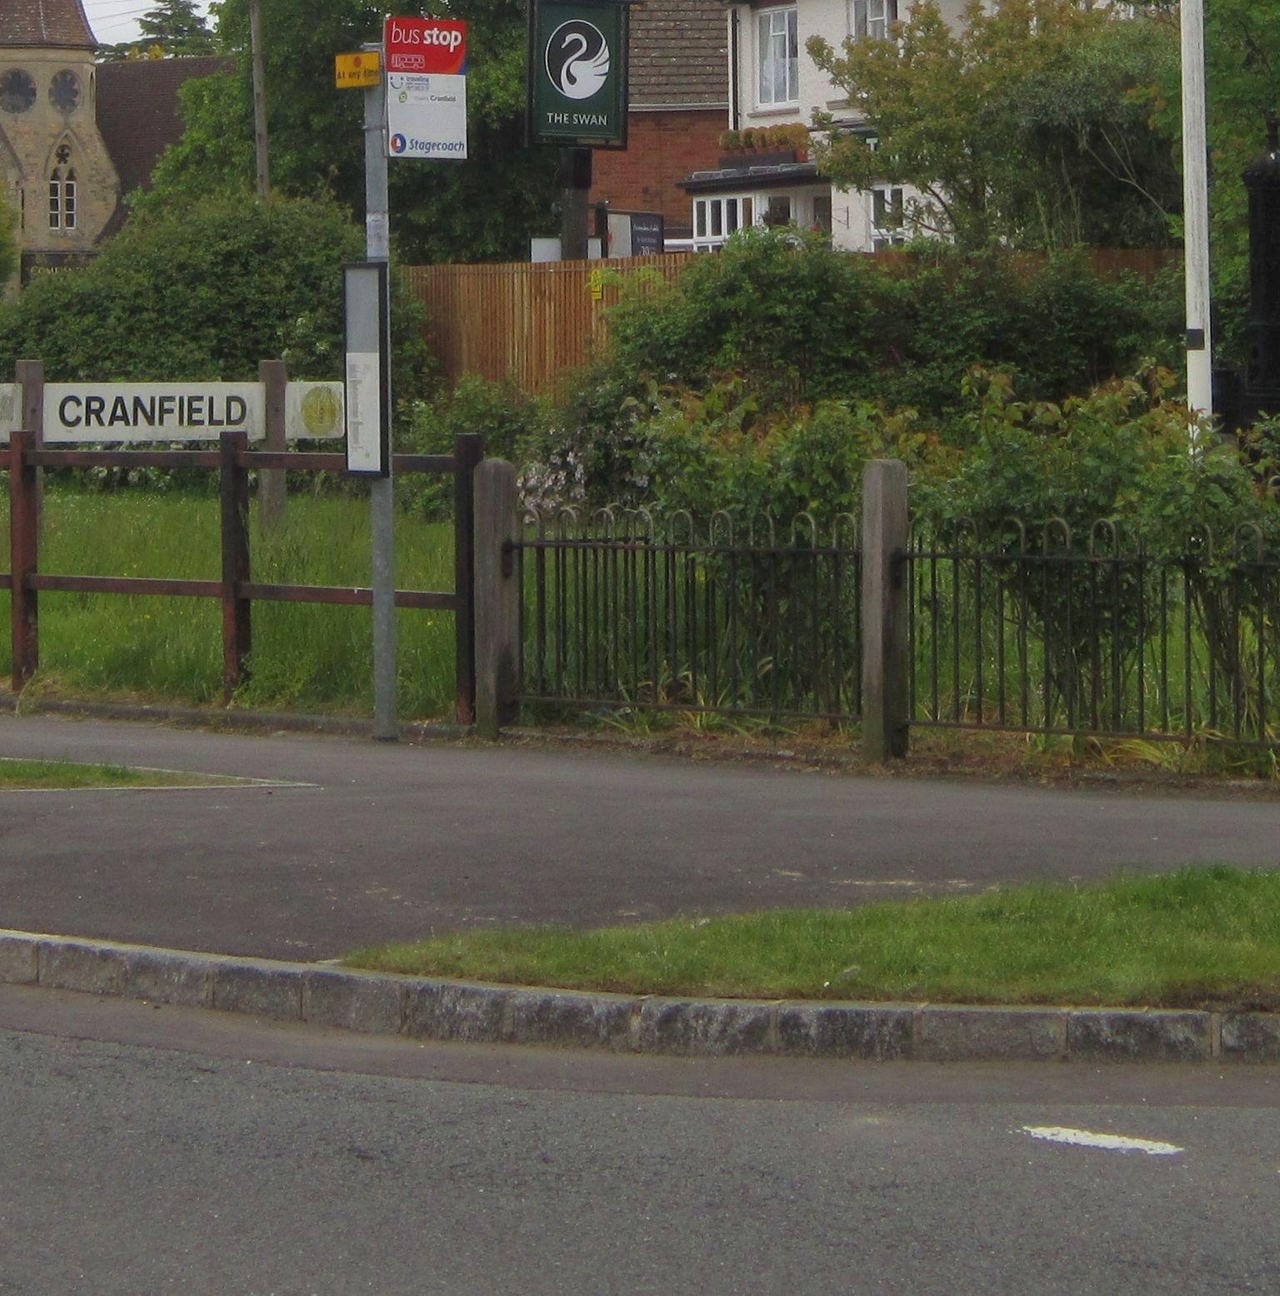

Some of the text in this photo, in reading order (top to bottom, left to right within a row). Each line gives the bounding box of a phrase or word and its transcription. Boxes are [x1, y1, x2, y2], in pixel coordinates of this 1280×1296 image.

[391, 21, 462, 53] bus stop
[547, 112, 607, 126] THE SWAN
[409, 138, 465, 154] Stagecoach
[58, 394, 248, 428] CRANFIELD
